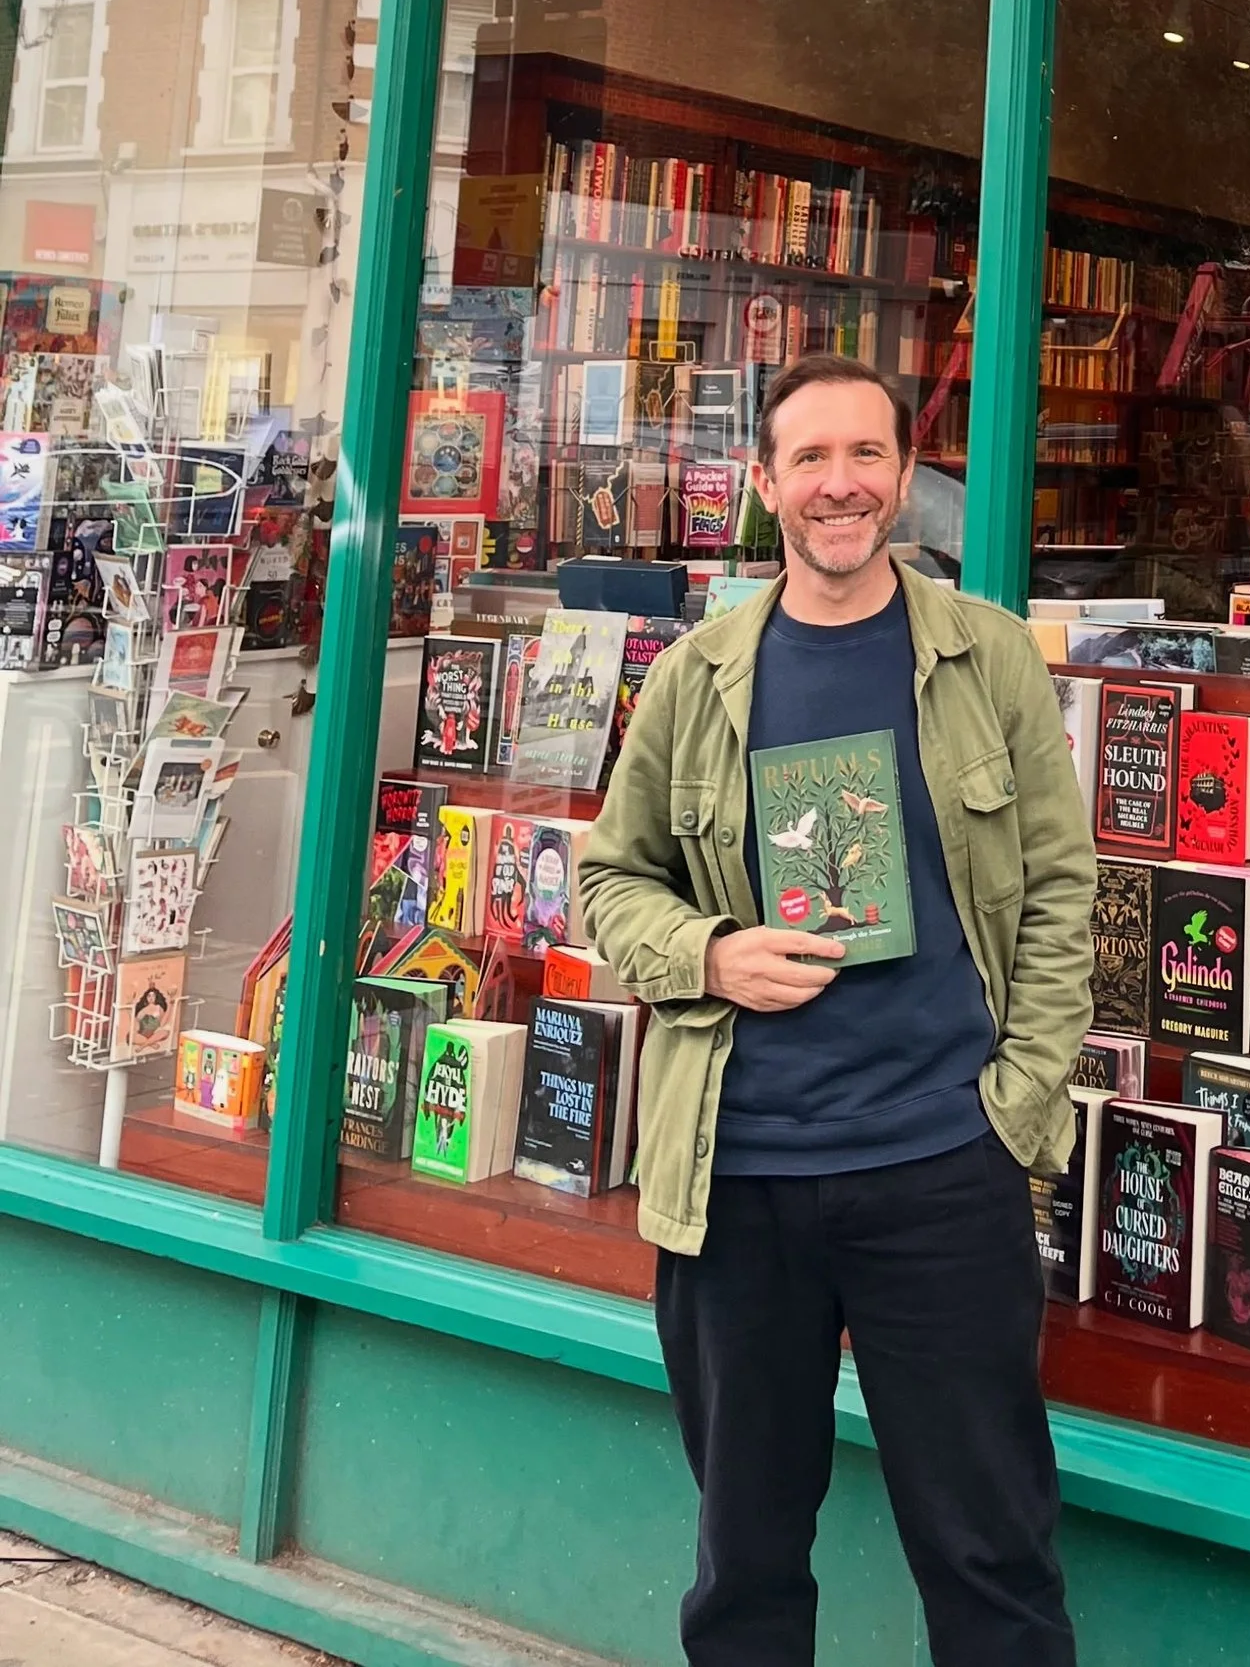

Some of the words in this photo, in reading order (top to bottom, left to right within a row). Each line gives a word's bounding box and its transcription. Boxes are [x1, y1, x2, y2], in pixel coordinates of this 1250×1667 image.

[592, 155, 605, 221] ATWOOD
[685, 481, 714, 492] Guide
[715, 481, 728, 492] to
[693, 470, 728, 482] Pocket
[625, 637, 665, 652] OTANICA
[434, 669, 464, 683] WORST
[441, 681, 467, 694] THING
[1117, 703, 1156, 722] Lindsey
[1105, 718, 1169, 734] FITZHARRIS
[763, 748, 882, 789] RITUALS
[1103, 744, 1167, 768] SLEUTH
[1102, 767, 1167, 793] HOUND
[1093, 934, 1147, 960] ORTONS
[1161, 940, 1234, 993] Galinda
[535, 1007, 582, 1032] MARIANA
[1161, 1018, 1193, 1036] GREGORY
[1194, 1025, 1230, 1042] MAGUIRE
[534, 1021, 584, 1046] ENRIQUEZ
[346, 1050, 401, 1085] RAITORS'
[432, 1061, 464, 1085] JEKYLL
[351, 1081, 381, 1112] NEST
[425, 1080, 467, 1113] HYDE
[540, 1070, 578, 1092] THINGS
[578, 1080, 595, 1099] WE
[555, 1089, 580, 1109] LOST
[580, 1095, 594, 1113] IN
[1195, 1086, 1229, 1109] Things
[549, 1102, 569, 1122] THE
[569, 1107, 592, 1128] FIRE
[343, 1117, 385, 1139] FRANCES
[1135, 1160, 1149, 1175] THE
[1120, 1168, 1164, 1204] HOUSE
[1115, 1203, 1168, 1241] CURSED
[1102, 1228, 1181, 1274] DAUGHTERS
[1128, 1296, 1174, 1322] COOKE
